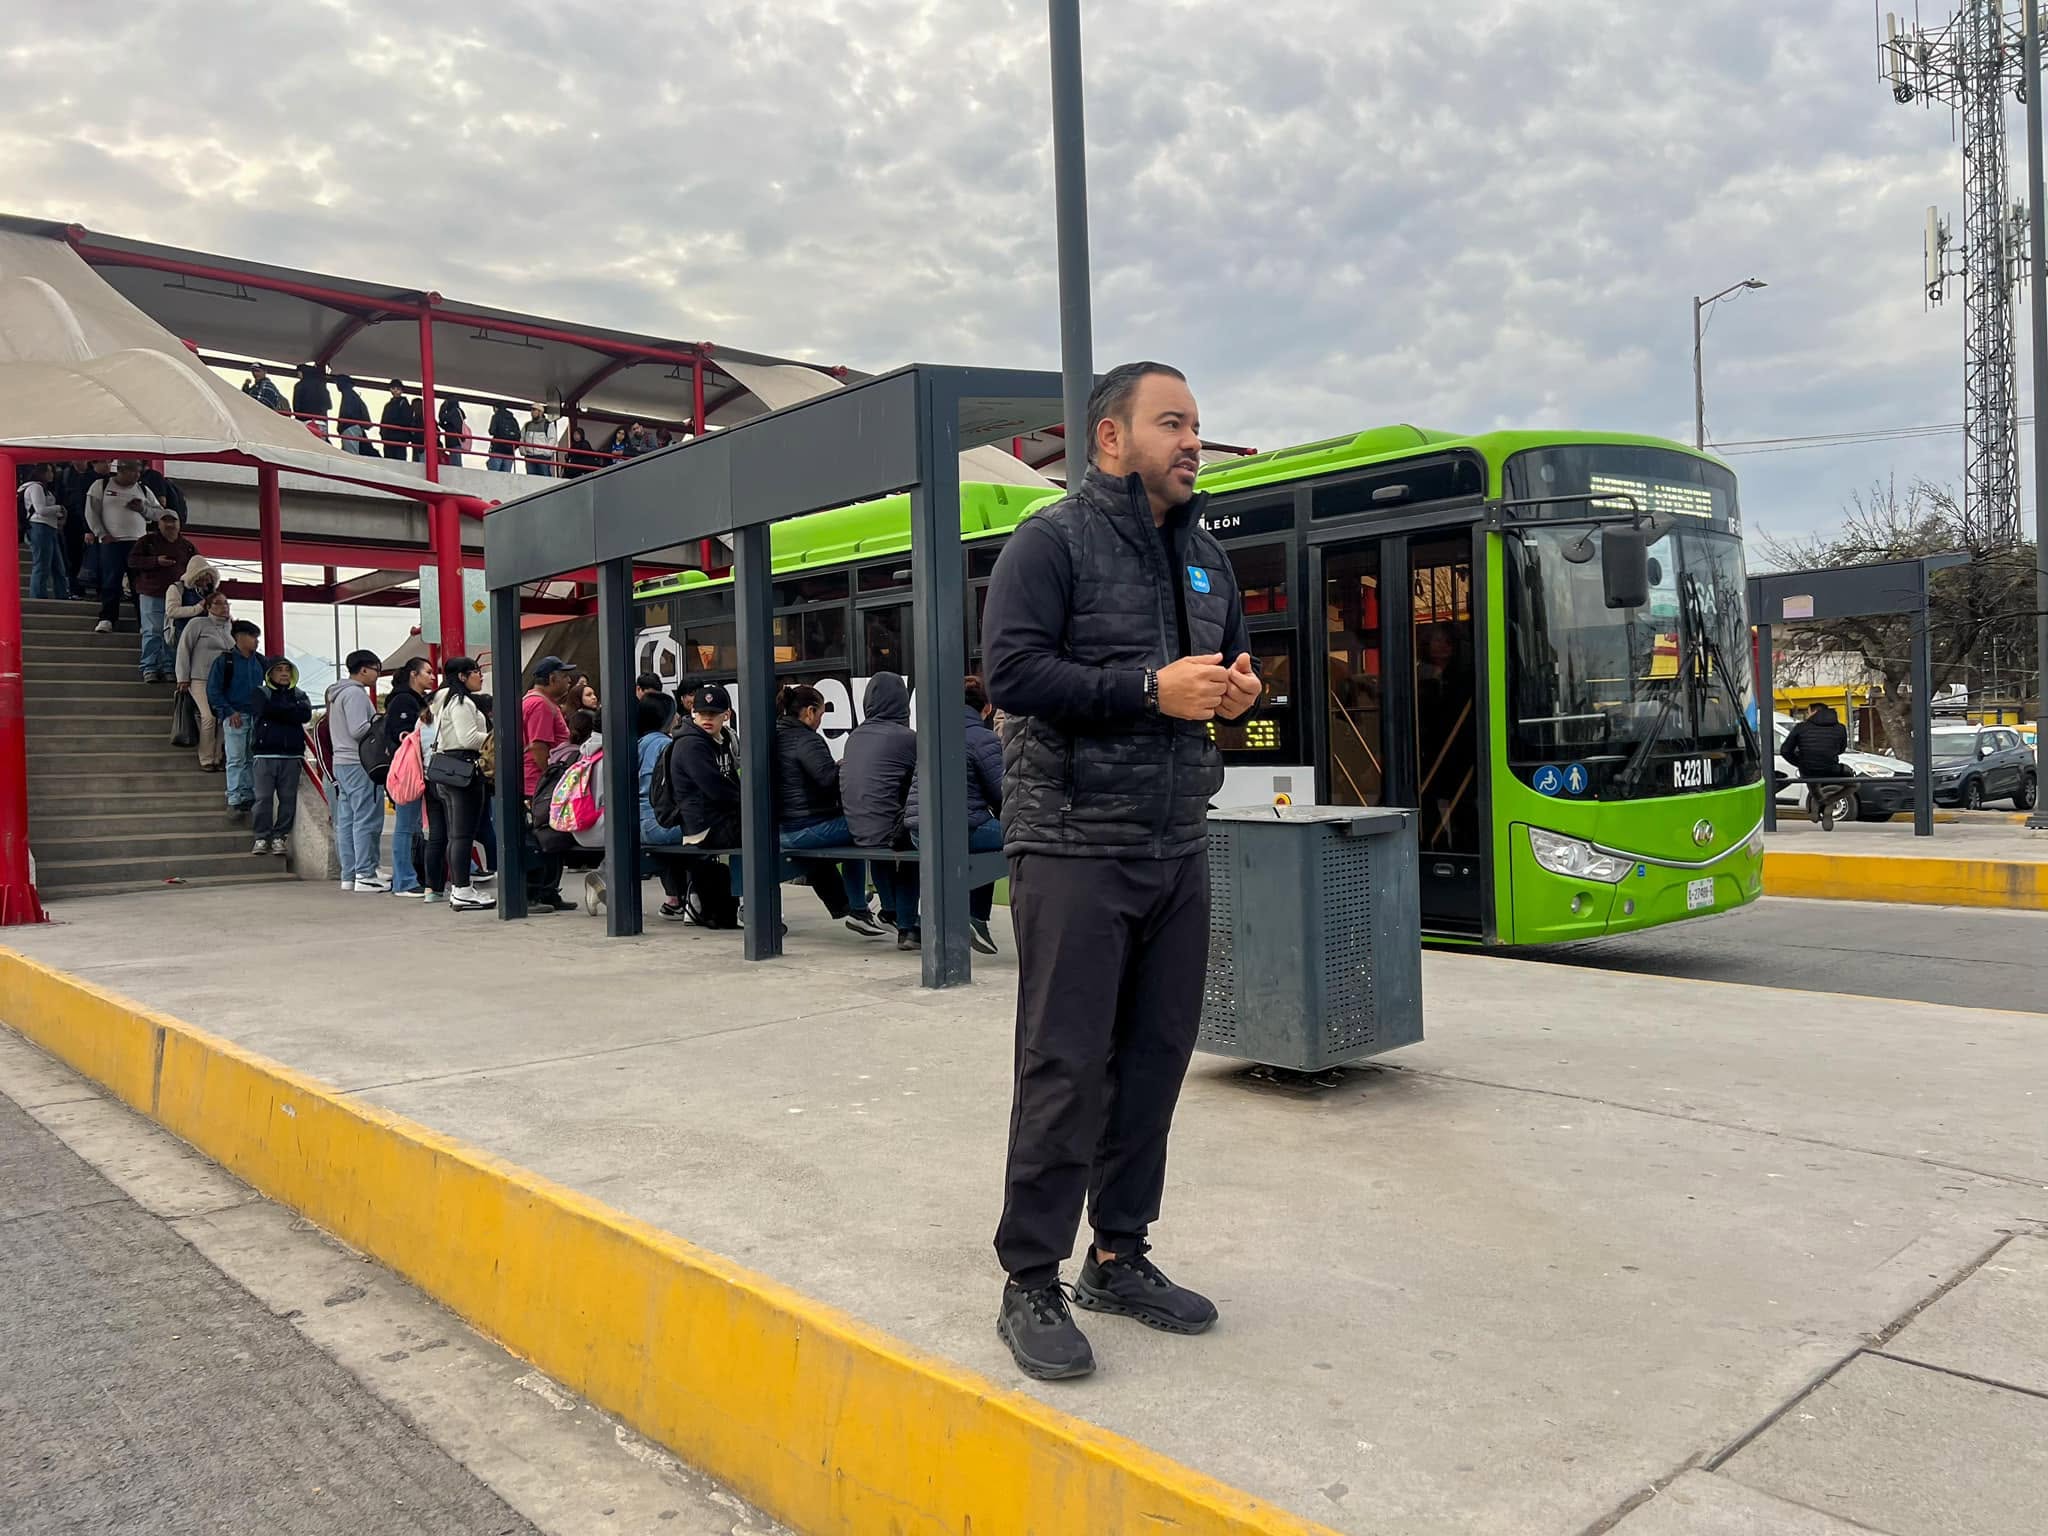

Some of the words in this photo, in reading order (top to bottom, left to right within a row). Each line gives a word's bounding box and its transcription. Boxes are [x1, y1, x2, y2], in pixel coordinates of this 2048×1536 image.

[1206, 515, 1240, 530] LEÓN
[1673, 760, 1701, 787] R-223
[1704, 759, 1712, 785] M
